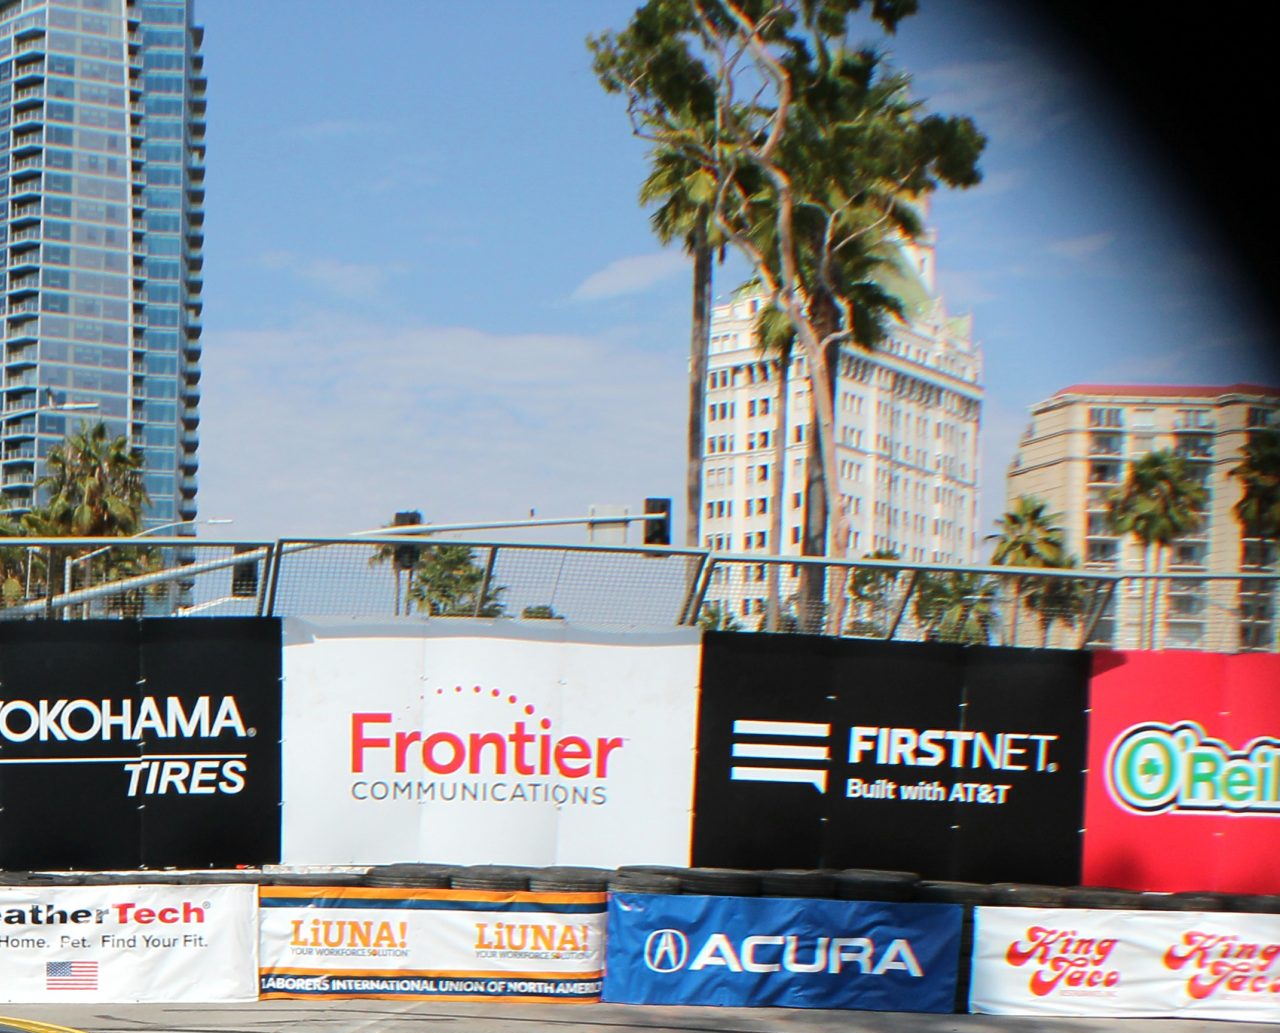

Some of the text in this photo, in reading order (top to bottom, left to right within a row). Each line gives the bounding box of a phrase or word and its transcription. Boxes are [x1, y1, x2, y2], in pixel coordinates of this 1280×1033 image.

[351, 712, 624, 779] Frontier
[848, 726, 1058, 772] FIRSTNET
[124, 760, 247, 797] TIRES
[351, 781, 608, 806] COMMUNICATIONS
[846, 779, 1012, 805] Built with AT&T
[60, 935, 91, 949] Pet.
[101, 934, 136, 948] Find
[142, 934, 178, 948] Your
[183, 934, 209, 948] Fit.
[290, 918, 408, 949] LiUNA!
[474, 921, 590, 951] LiUNA!
[1004, 925, 1121, 968] King
[1160, 929, 1280, 972] King
[688, 933, 925, 978] ACURA
[261, 977, 329, 991] LABORERS
[331, 978, 438, 992] INTERNATIONAL
[439, 980, 485, 992] UNION
[486, 981, 507, 993] OF
[508, 981, 555, 994] NORTH
[1029, 956, 1121, 997] Taco
